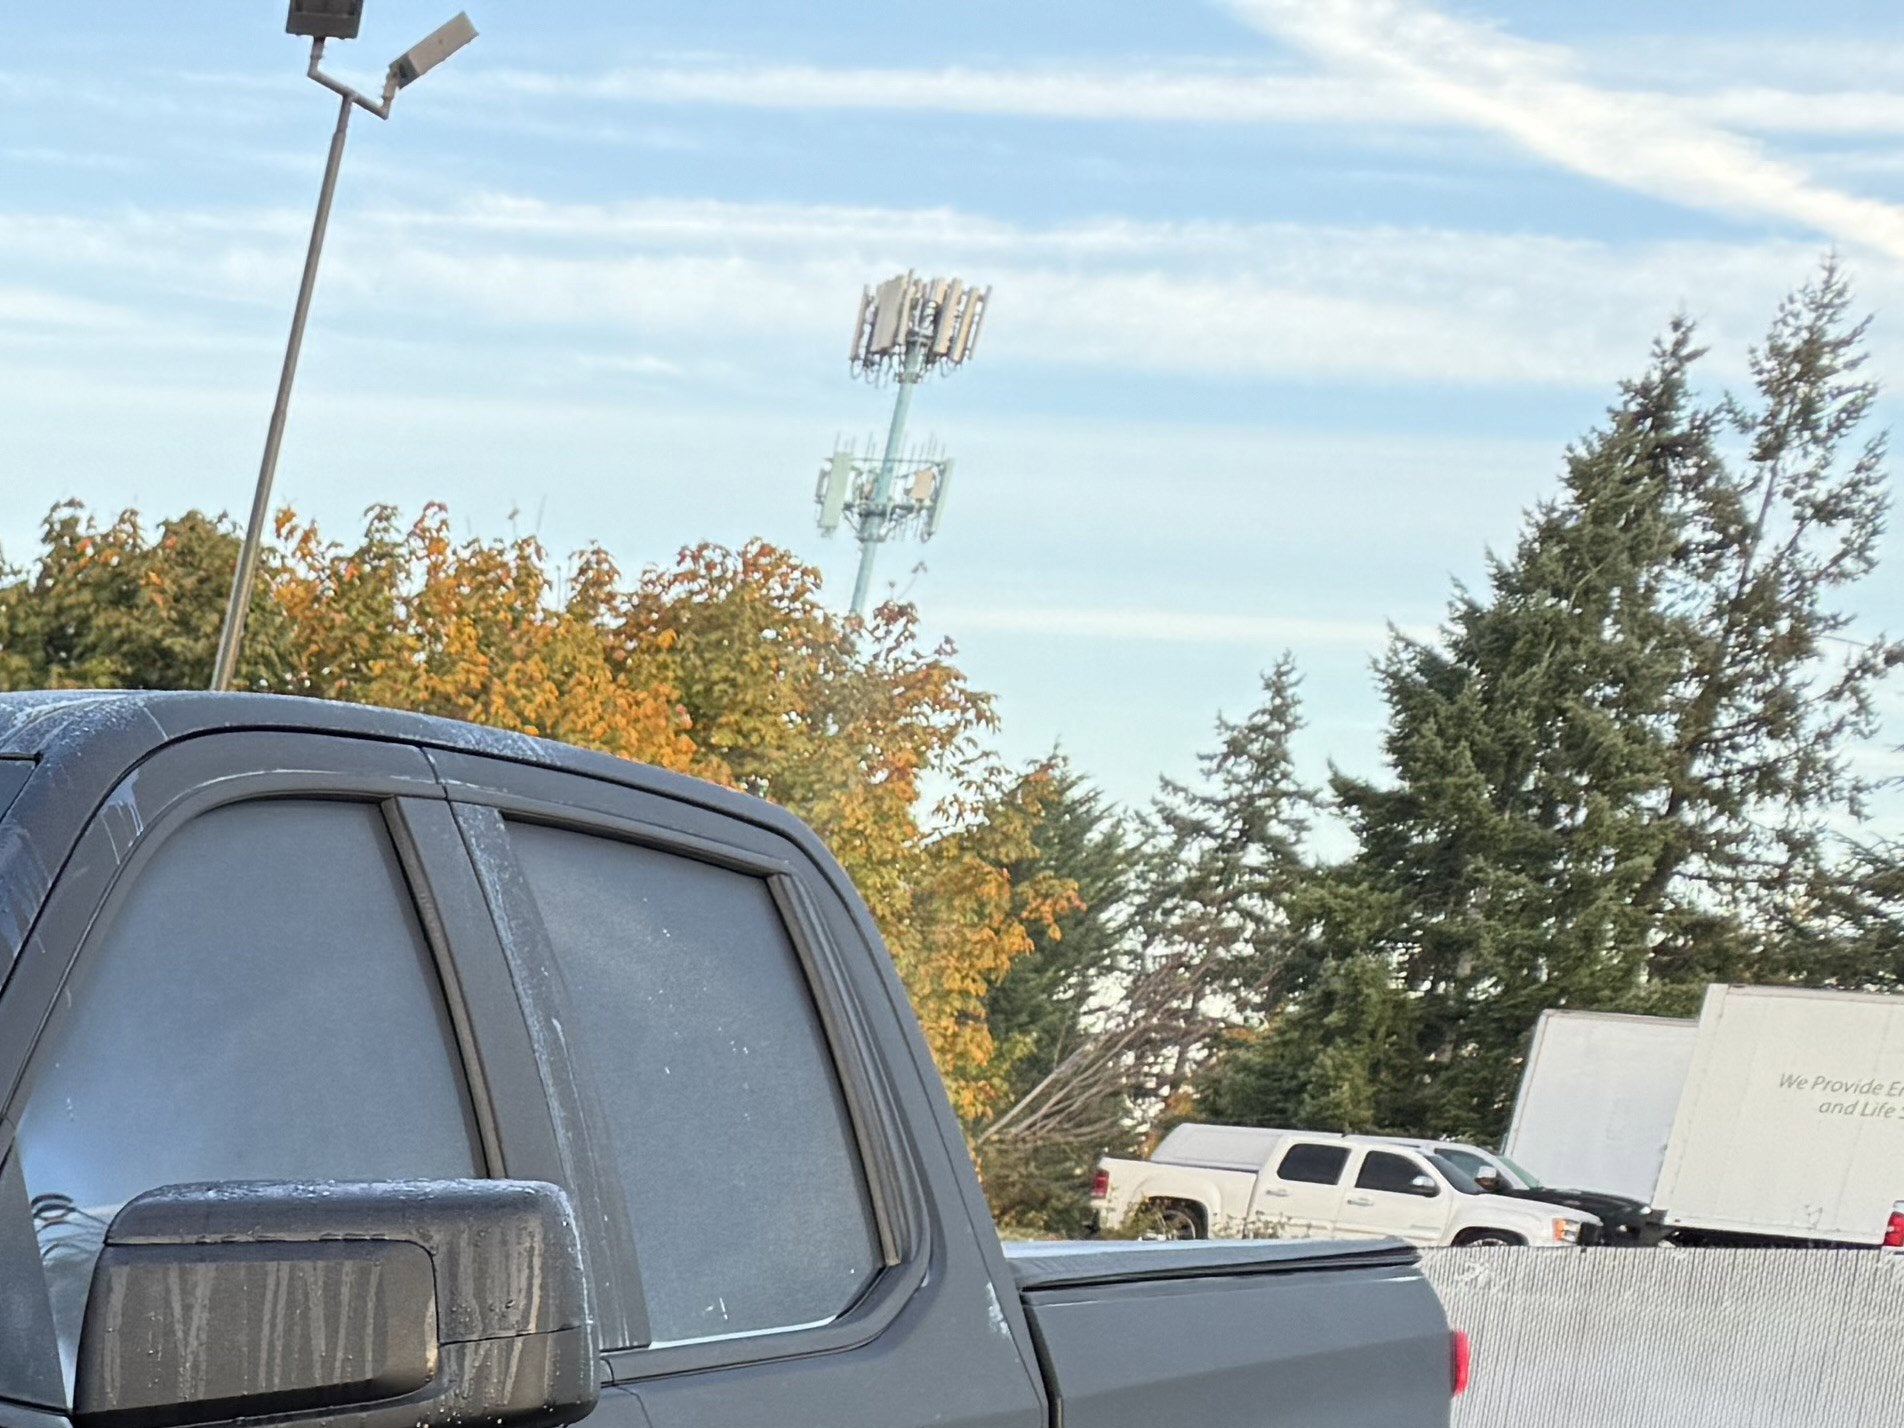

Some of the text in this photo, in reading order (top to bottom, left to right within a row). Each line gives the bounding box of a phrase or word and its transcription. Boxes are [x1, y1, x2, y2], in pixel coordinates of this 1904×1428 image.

[1779, 1073, 1808, 1090] We
[1812, 1076, 1884, 1095] Provide
[1819, 1100, 1860, 1115] and
[1860, 1101, 1896, 1118] Life
